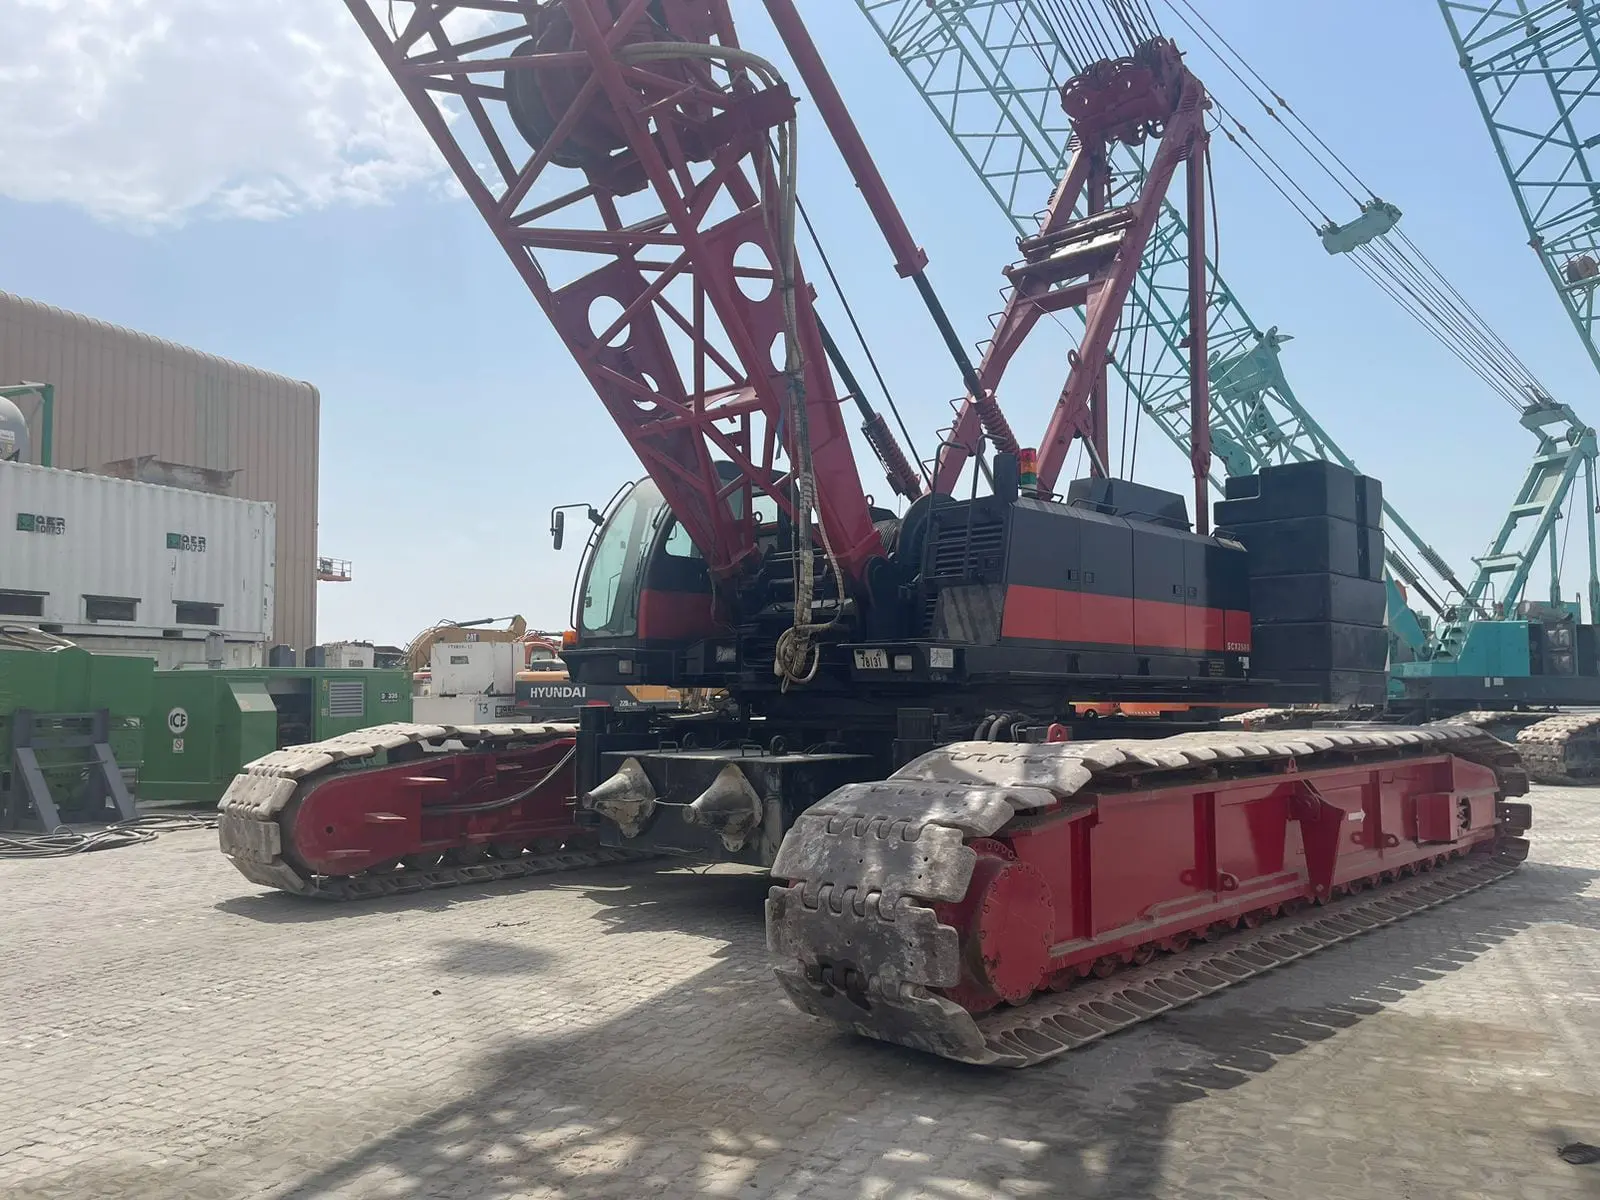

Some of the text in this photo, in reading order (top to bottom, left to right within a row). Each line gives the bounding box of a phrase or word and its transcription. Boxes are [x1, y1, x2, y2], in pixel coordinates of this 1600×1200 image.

[530, 686, 586, 698] HYUNDAI
[478, 703, 489, 714] T3
[170, 713, 186, 728] ICE
